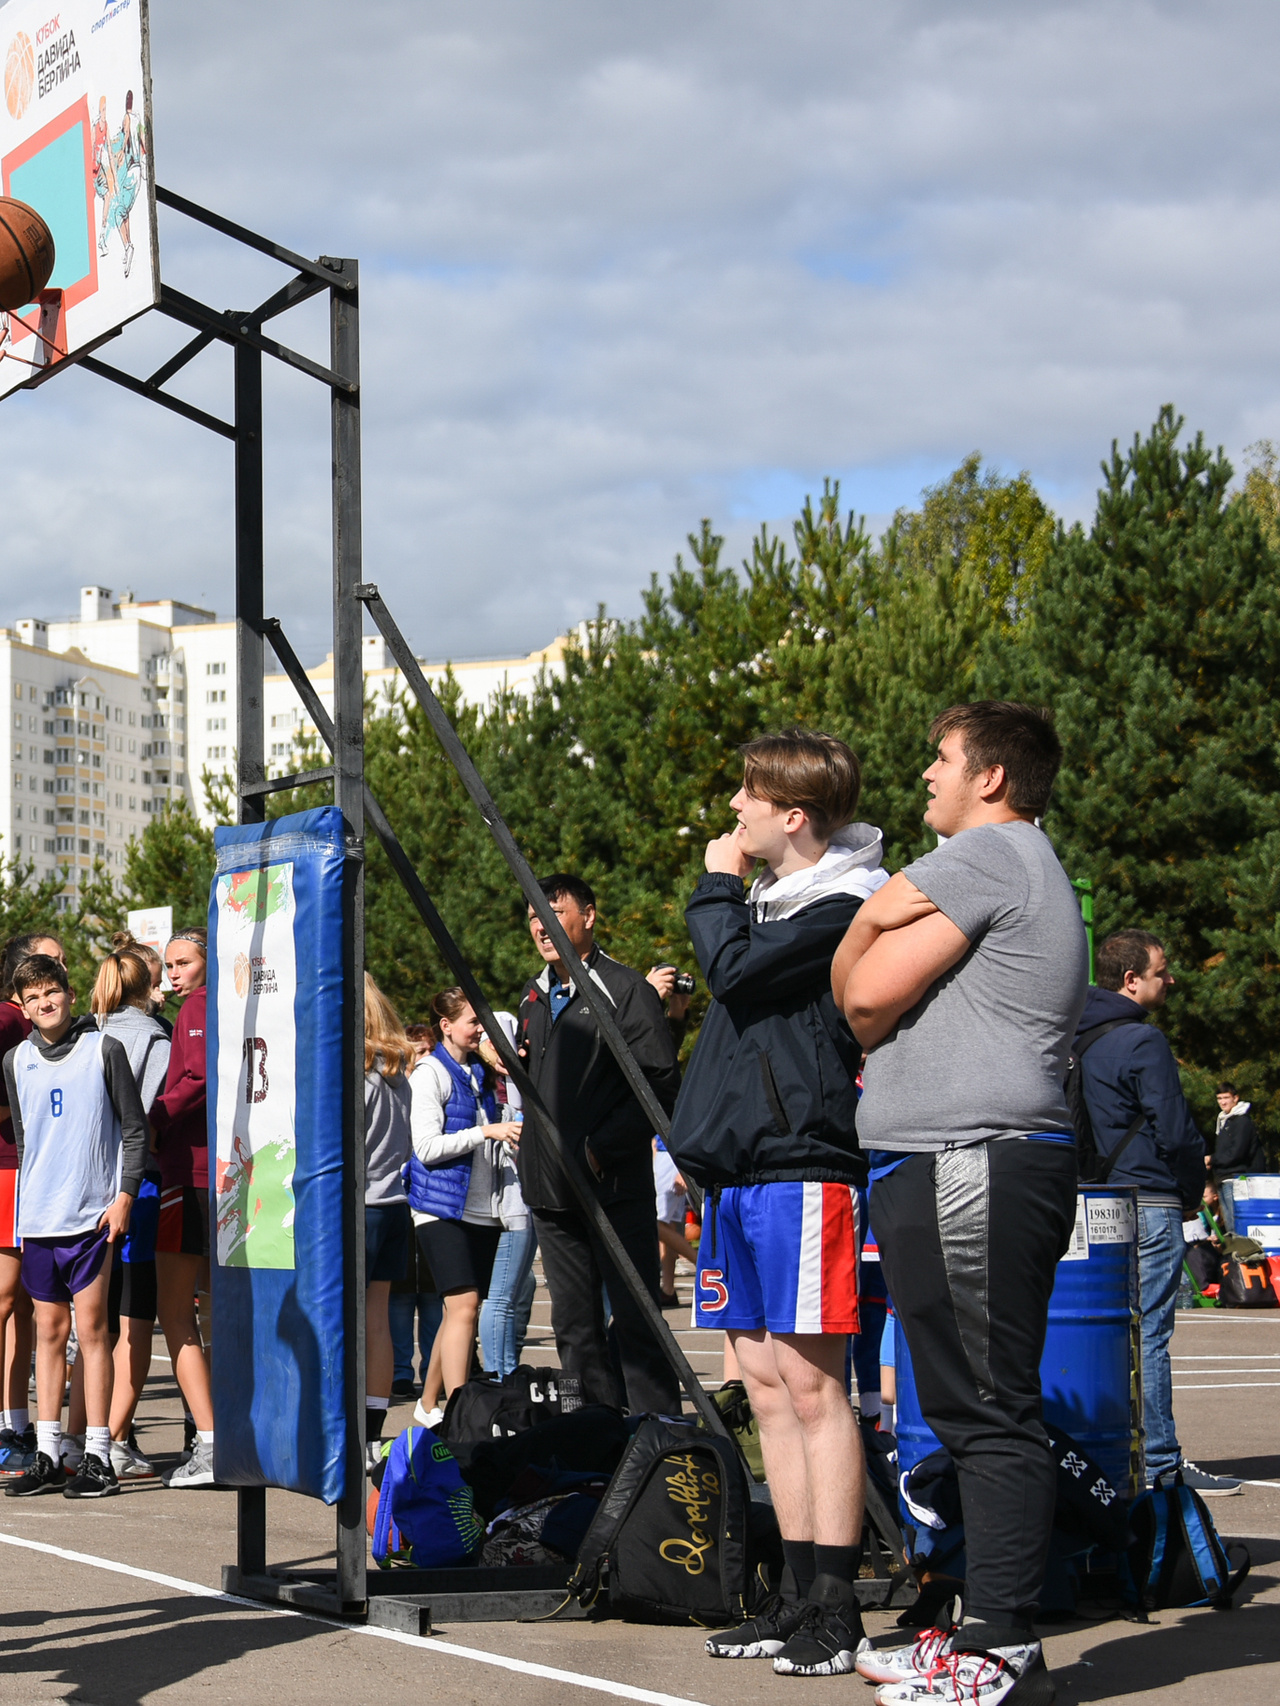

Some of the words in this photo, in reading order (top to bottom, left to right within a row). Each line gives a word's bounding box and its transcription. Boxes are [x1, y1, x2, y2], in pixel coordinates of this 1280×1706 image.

[36, 13, 60, 47] КУБОК
[37, 29, 76, 79] ДАВИДА
[50, 1088, 63, 1117] 8
[1089, 1208, 1120, 1220] 198310
[700, 1269, 729, 1311] 5
